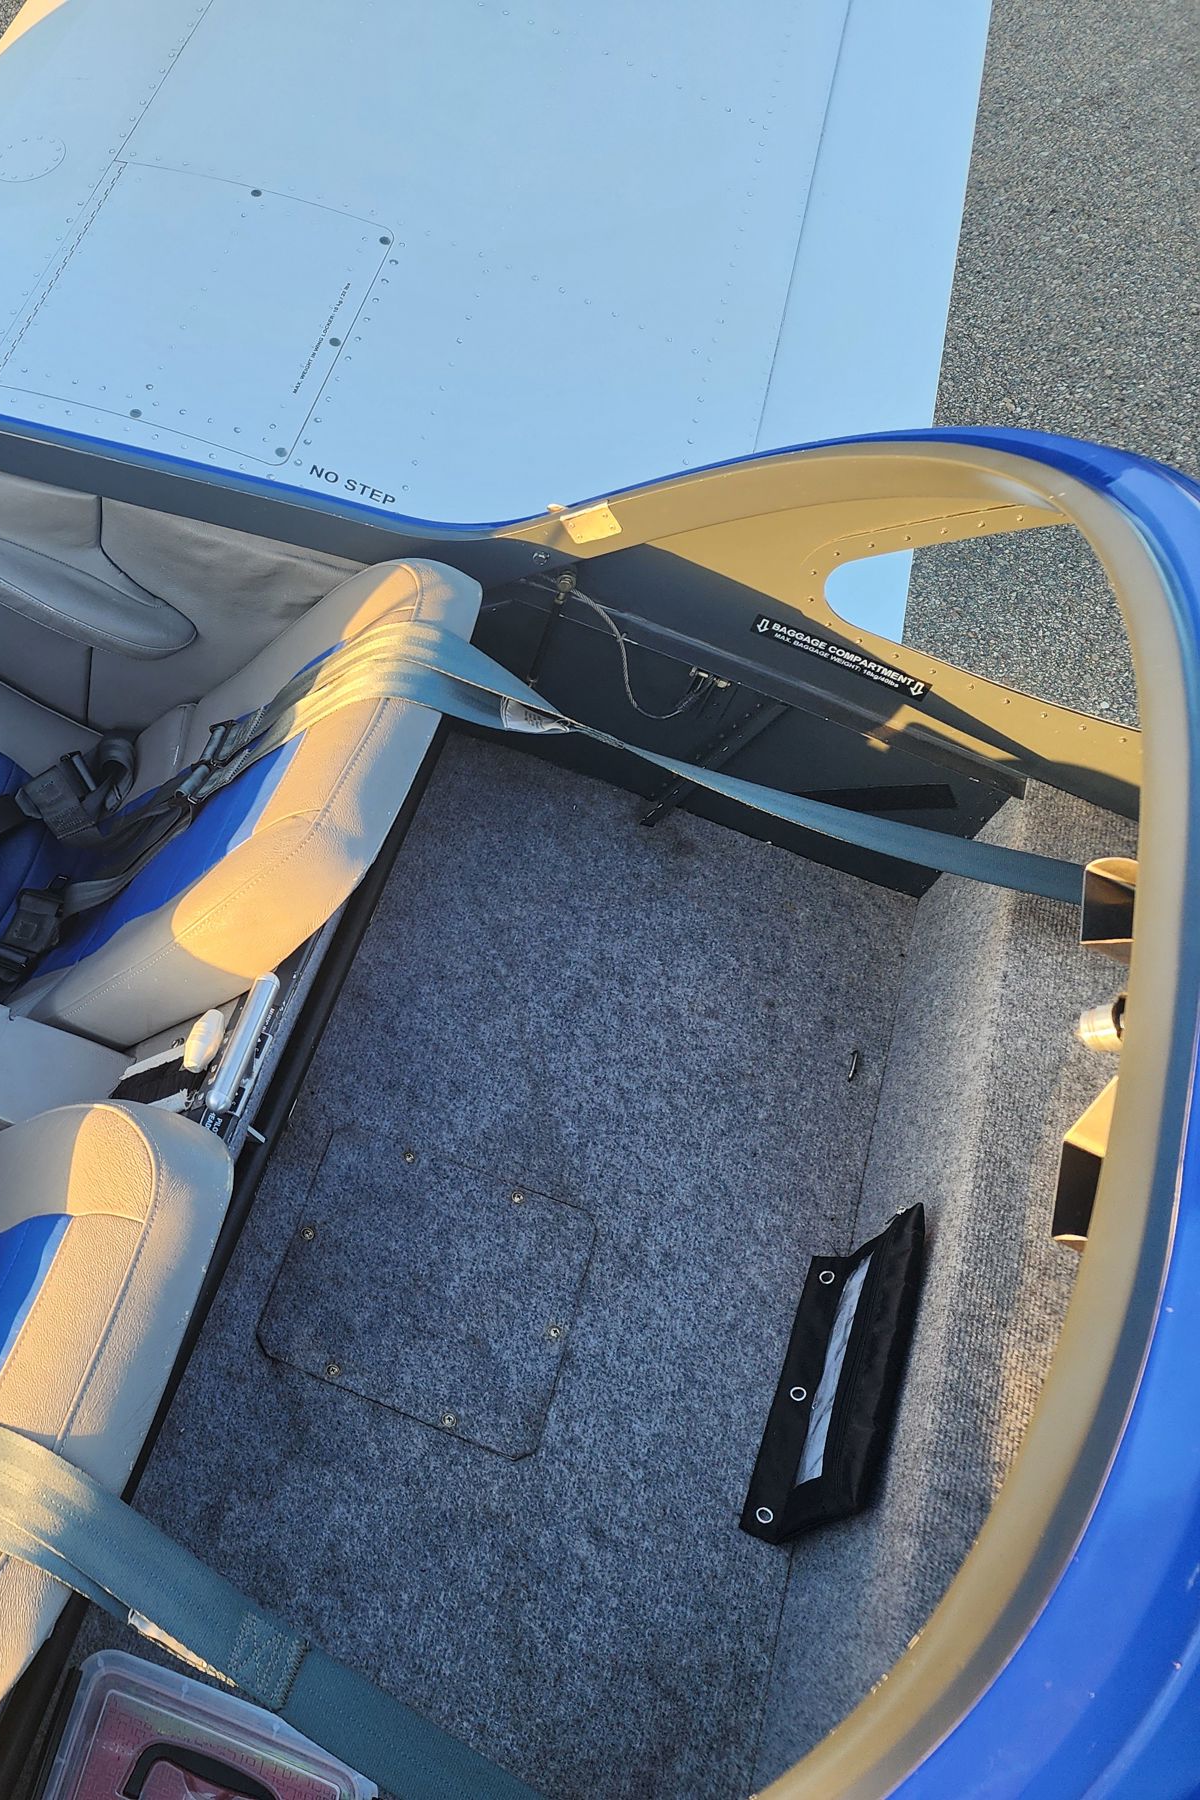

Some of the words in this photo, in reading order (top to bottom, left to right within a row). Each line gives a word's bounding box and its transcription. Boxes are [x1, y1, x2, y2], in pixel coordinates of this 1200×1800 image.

[299, 358, 313, 380] WEIGHT
[314, 336, 324, 352] WING
[309, 464, 339, 484] NO
[344, 478, 396, 505] STEP
[771, 622, 828, 650] BAGGAGE
[828, 645, 915, 687] COMPARTMENT
[774, 632, 792, 644] MAX.
[792, 640, 829, 659] BAGGAGE
[830, 656, 862, 673] WEIGHT:
[211, 1117, 222, 1133] PILO
